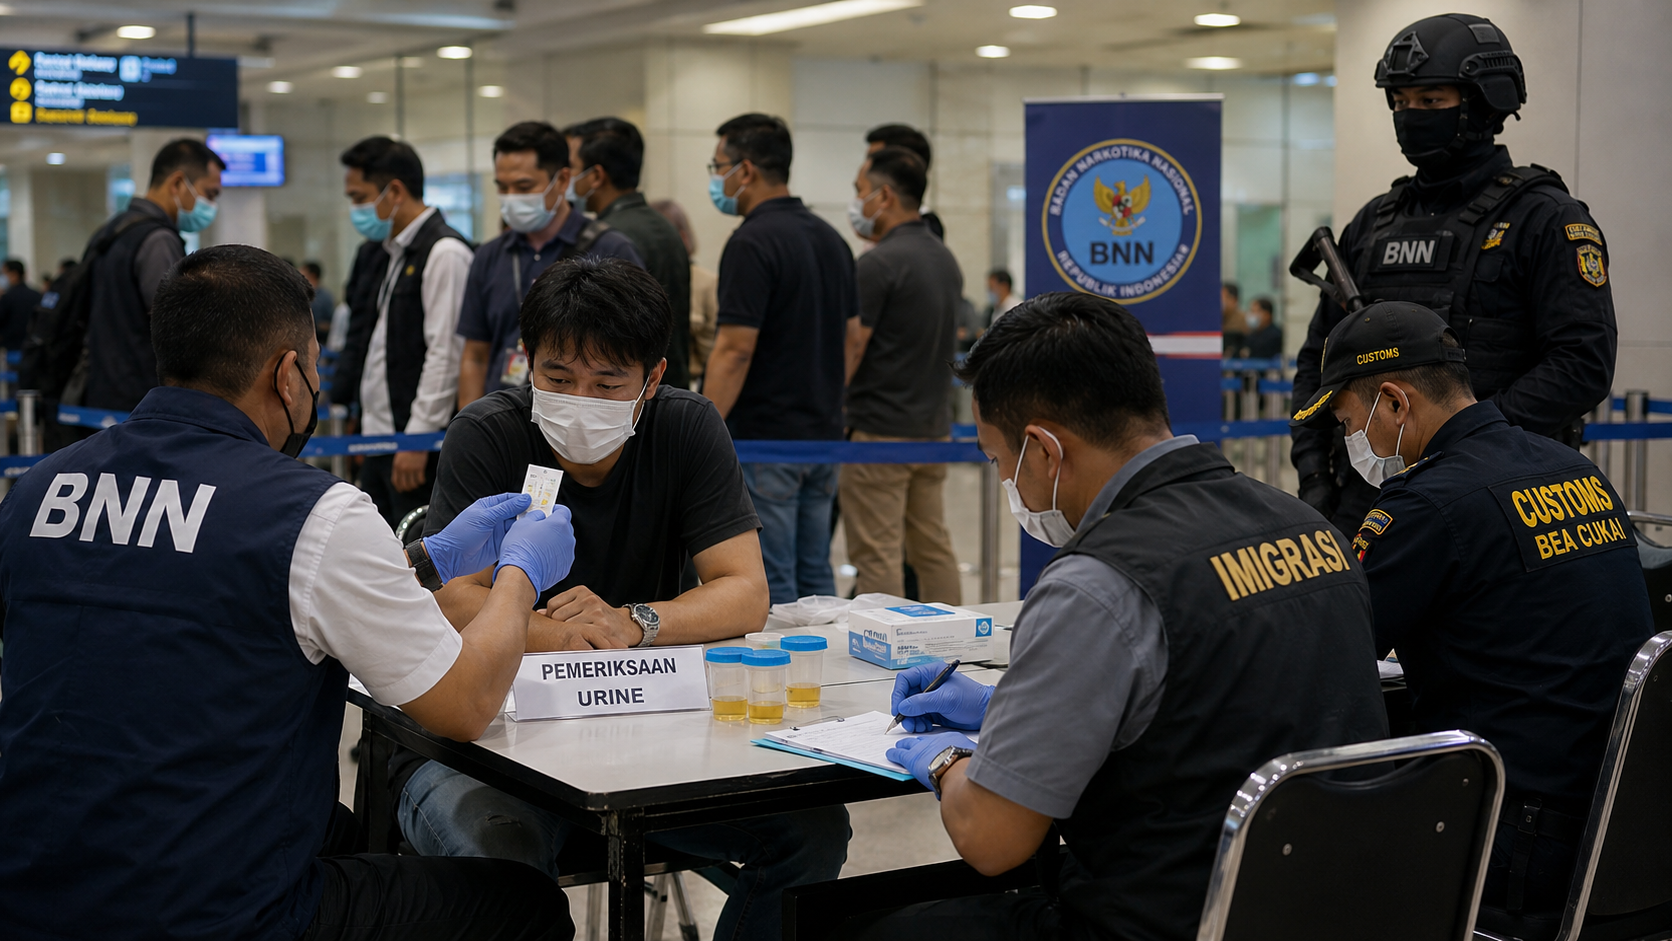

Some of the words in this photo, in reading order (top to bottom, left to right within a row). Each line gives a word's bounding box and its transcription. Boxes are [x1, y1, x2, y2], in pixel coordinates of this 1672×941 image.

[1050, 169, 1079, 216] BADAN
[1076, 145, 1150, 173] NARKOTIKA
[1152, 155, 1194, 216] NASIONAL
[1057, 250, 1117, 297] REPUBLIK
[1090, 242, 1154, 265] BNN
[1382, 240, 1435, 265] BNN
[1356, 347, 1400, 365] CUSTOMS
[29, 472, 217, 553] BNN
[1511, 475, 1614, 528] CUSTOMS
[1534, 528, 1579, 560] BEA
[1576, 517, 1627, 548] CUKAI
[1209, 530, 1351, 601] IMIGRASI
[541, 657, 677, 681] PEMERIKSAAN
[577, 687, 645, 707] URINE
